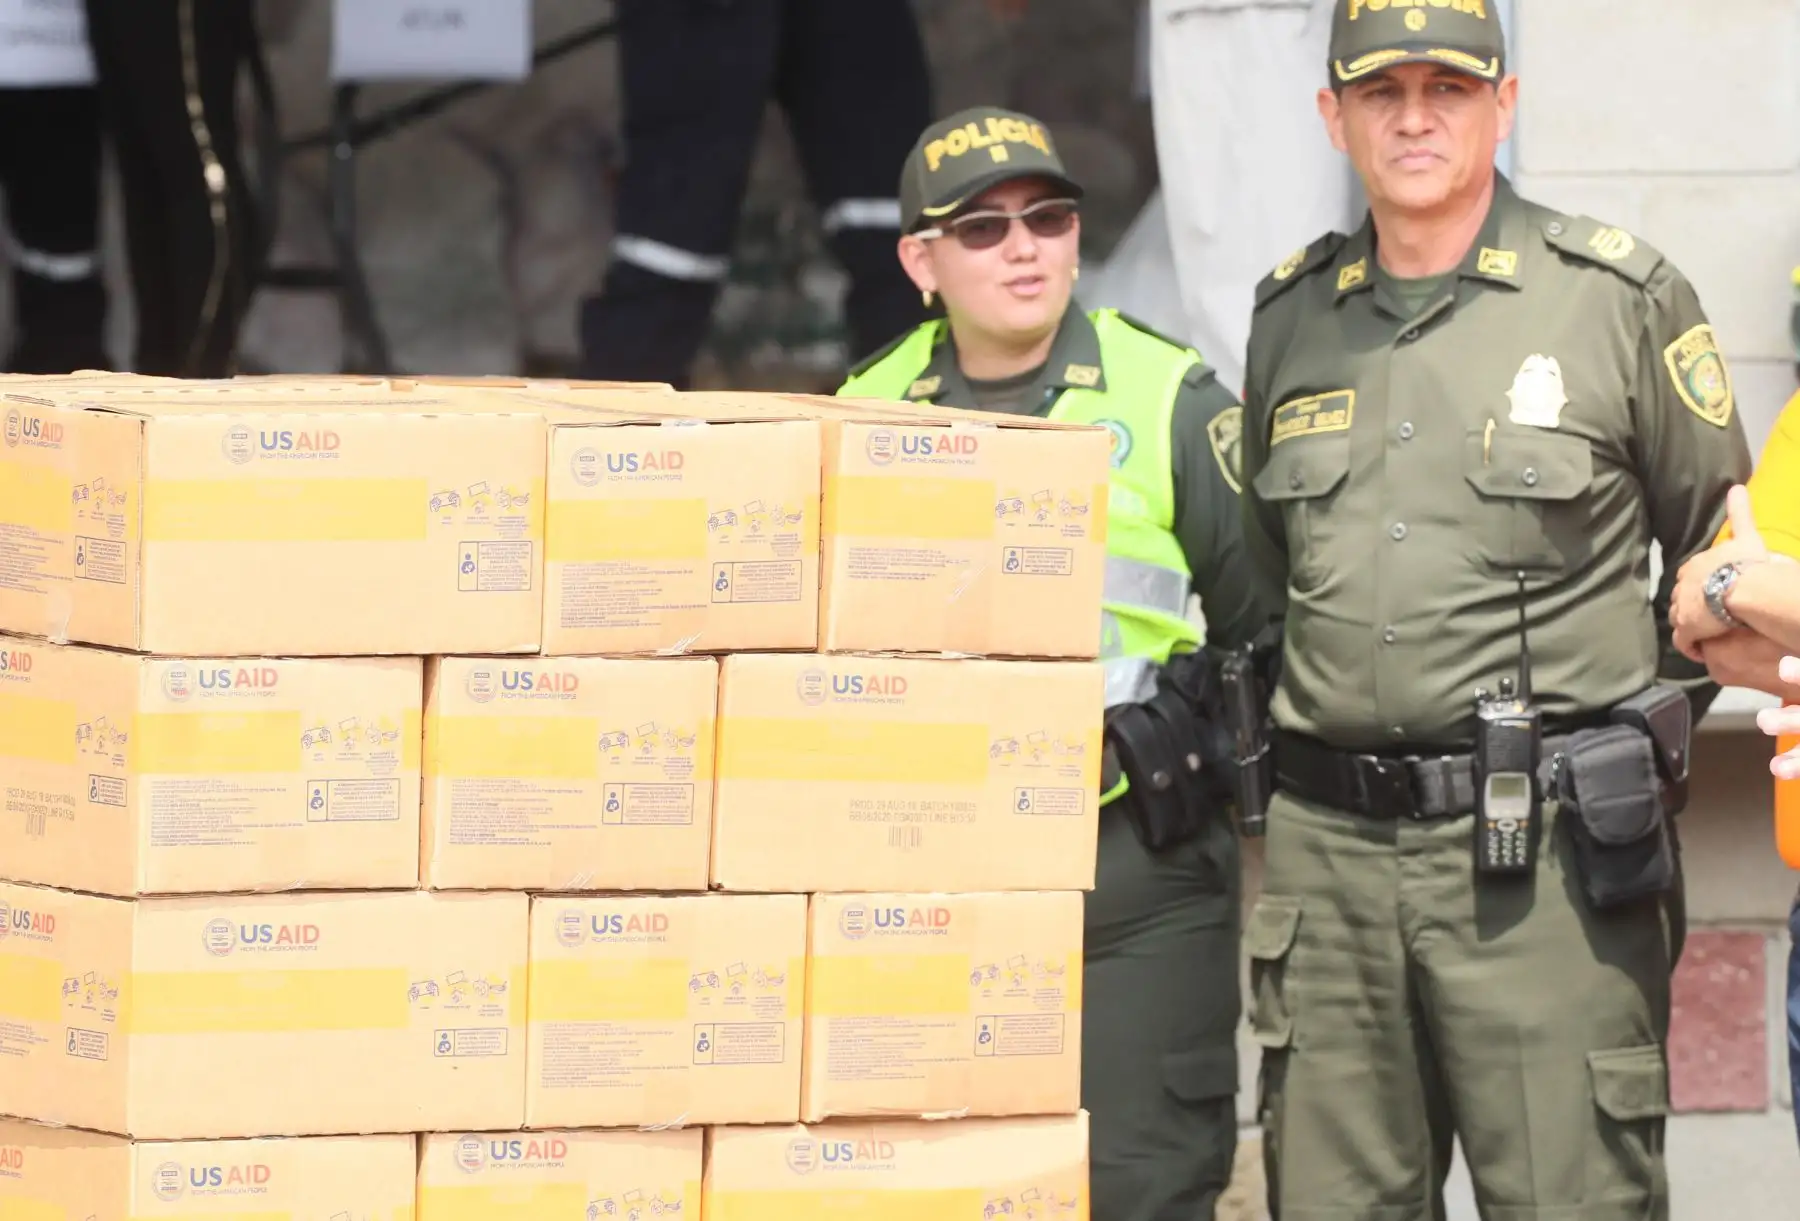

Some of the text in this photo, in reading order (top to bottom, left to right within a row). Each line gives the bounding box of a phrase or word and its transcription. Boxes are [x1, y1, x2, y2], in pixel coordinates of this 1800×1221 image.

[23, 416, 64, 443] USAID
[260, 431, 341, 451] USAID
[902, 434, 978, 455] USAID
[606, 451, 684, 472] USAID
[0, 651, 33, 673] SAID
[199, 668, 279, 689] USAID
[502, 671, 579, 691] USAID
[833, 675, 908, 695] USAID
[13, 909, 55, 934] USAID
[592, 912, 669, 934] USAID
[874, 908, 951, 928] USAID
[240, 924, 320, 944] USAID
[0, 1147, 23, 1169] AID
[491, 1140, 568, 1160] USAID
[822, 1141, 895, 1162] USAID
[190, 1164, 271, 1187] USAID
